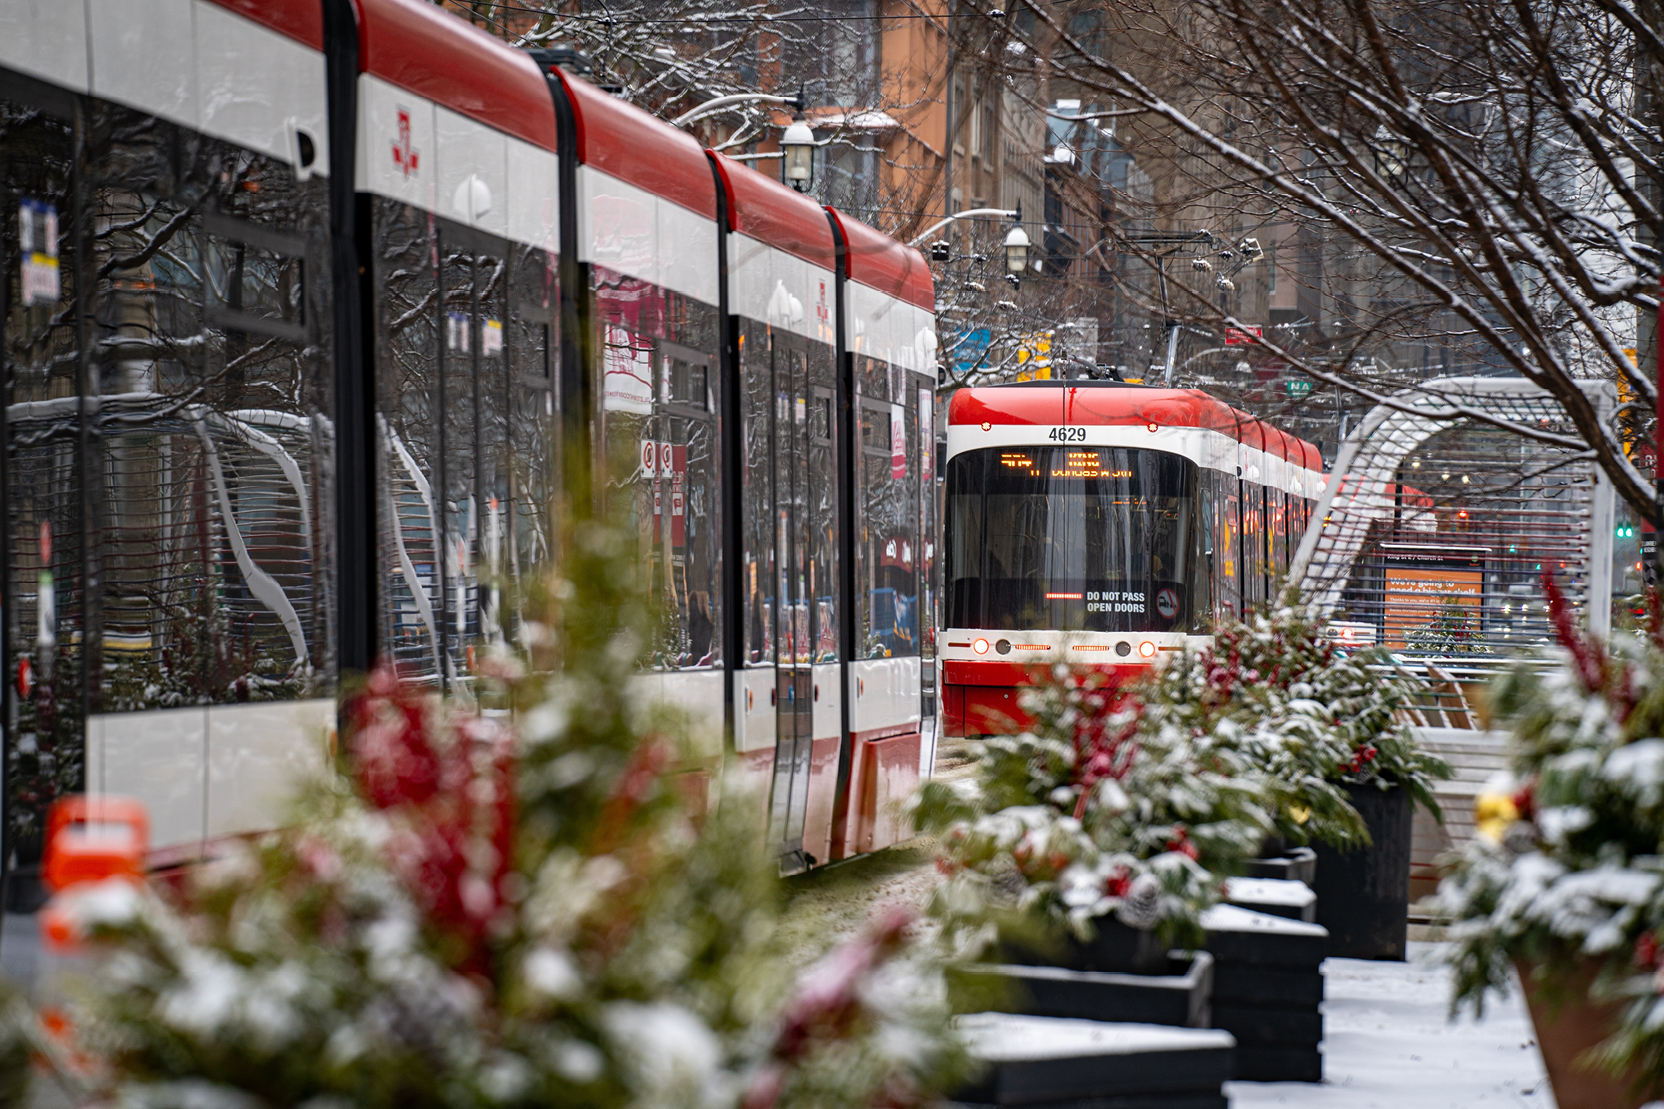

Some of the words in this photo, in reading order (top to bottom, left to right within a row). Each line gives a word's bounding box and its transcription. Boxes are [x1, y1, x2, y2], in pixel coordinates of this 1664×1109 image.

[1048, 427, 1087, 442] 4629
[1390, 577, 1416, 587] We're
[1417, 579, 1443, 589] going
[1445, 580, 1455, 588] to
[1389, 586, 1413, 594] need
[1086, 591, 1100, 601] DO
[1102, 591, 1120, 602] NOT
[1122, 592, 1145, 602] PASS
[1087, 603, 1112, 612] OPEN
[1114, 603, 1145, 613] DOORS
